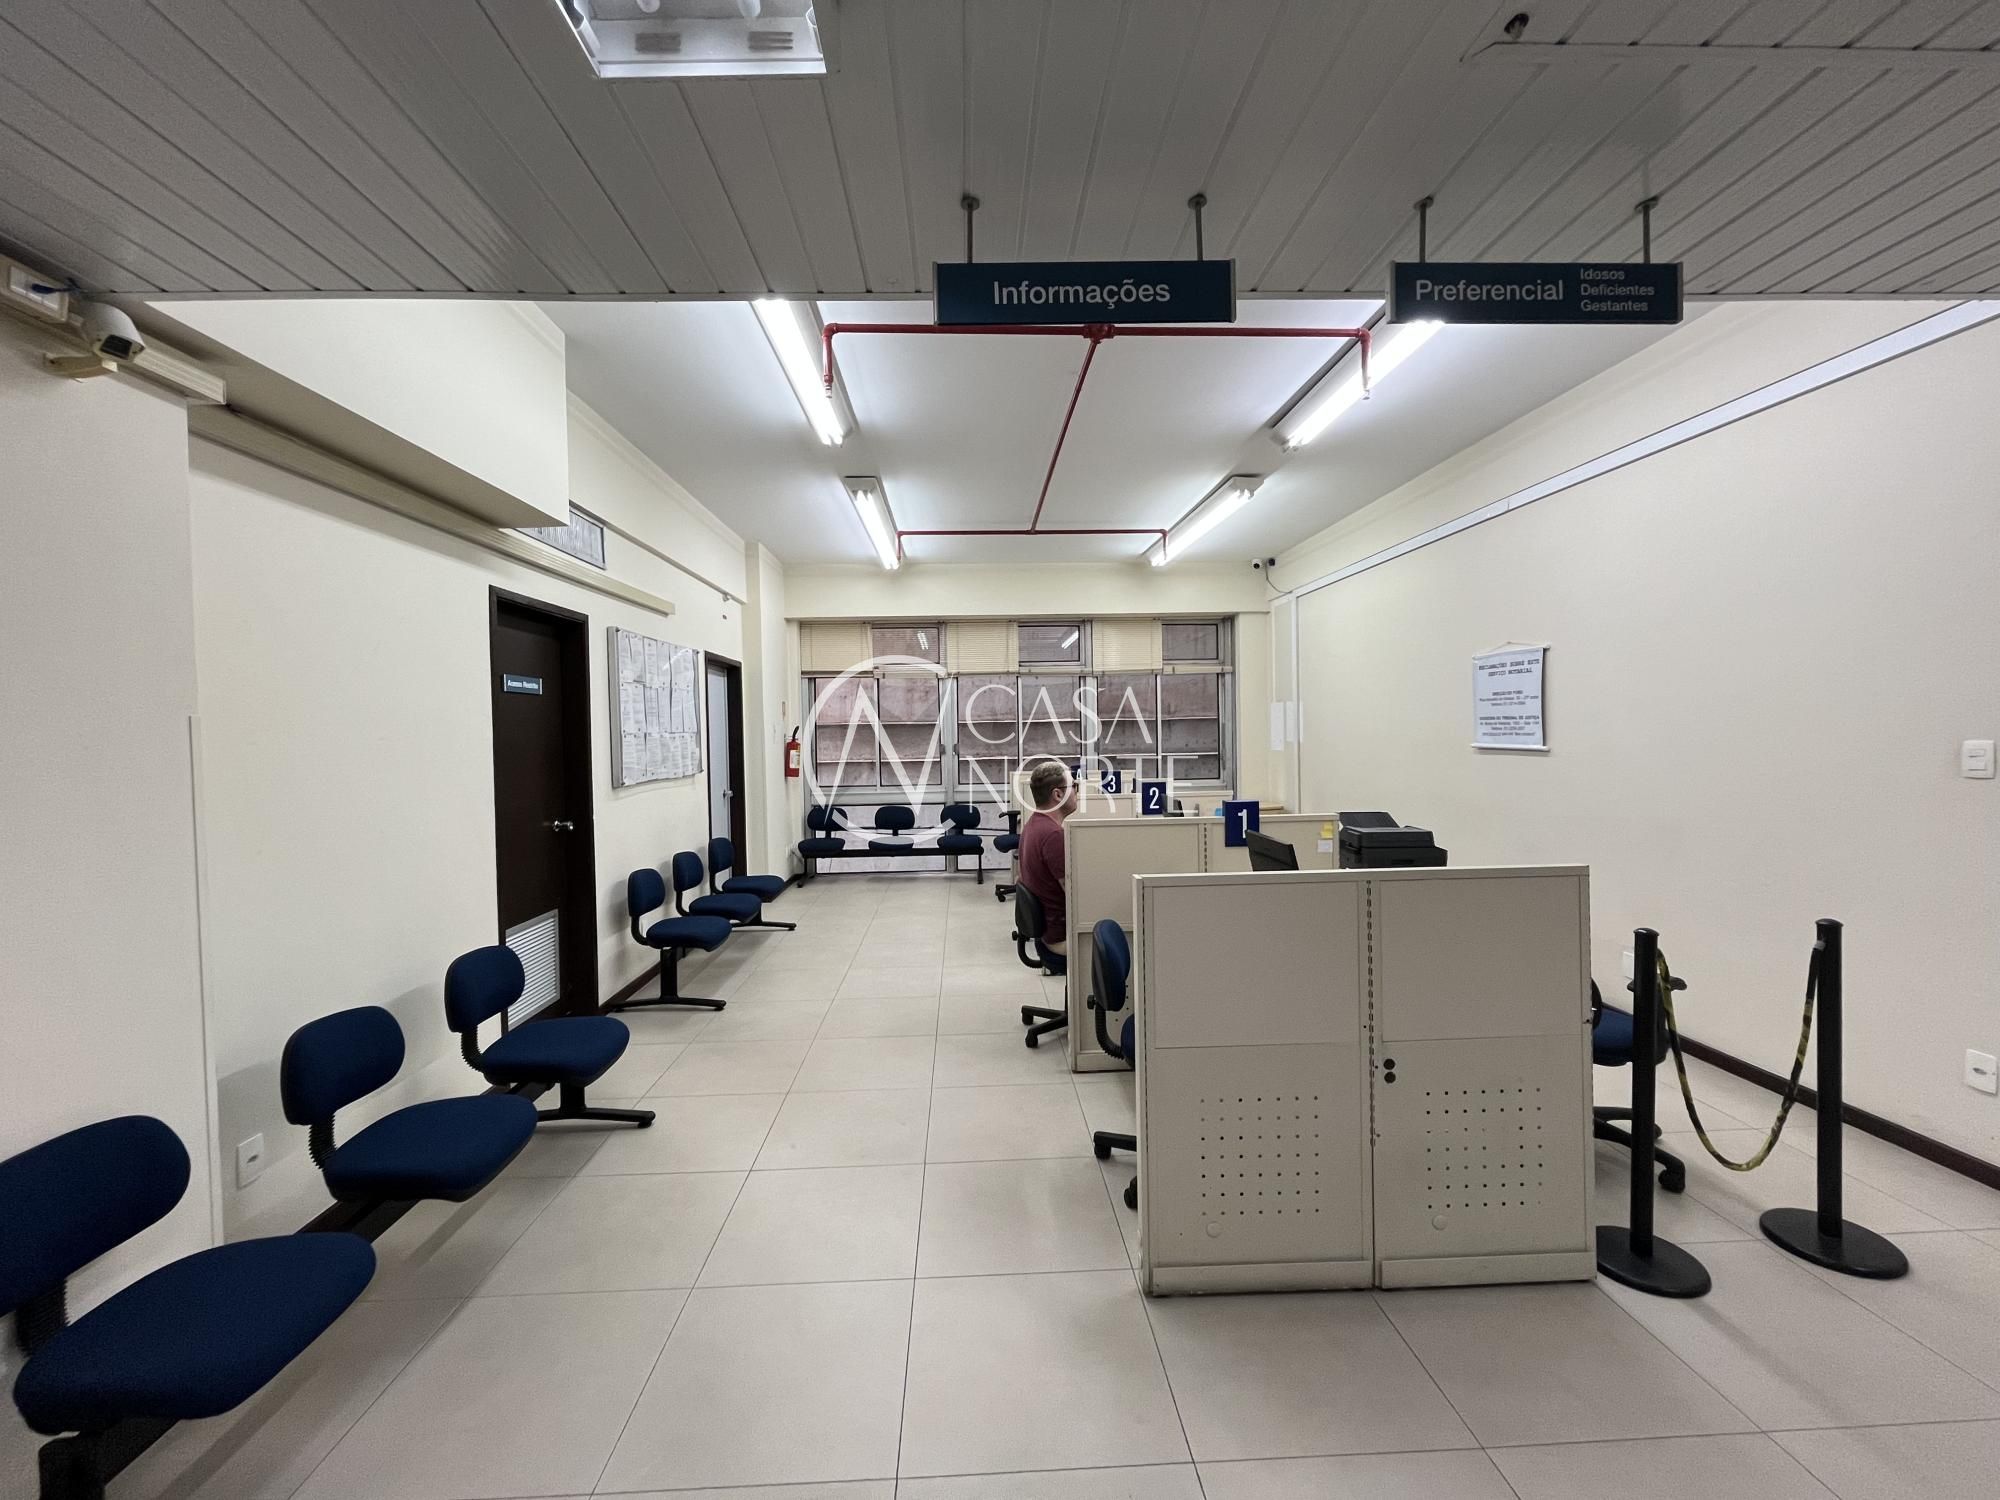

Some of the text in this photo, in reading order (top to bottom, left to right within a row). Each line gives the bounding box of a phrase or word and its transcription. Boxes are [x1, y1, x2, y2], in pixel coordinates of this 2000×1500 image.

[1580, 267, 1626, 280] Idosos
[993, 278, 1171, 309] Informações
[1414, 279, 1565, 302] Preferencial
[1580, 283, 1655, 296] Deficientes
[1580, 299, 1649, 312] Gestantes
[1107, 775, 1116, 793] 3
[1149, 787, 1160, 809] 2
[1238, 809, 1248, 839] 1
